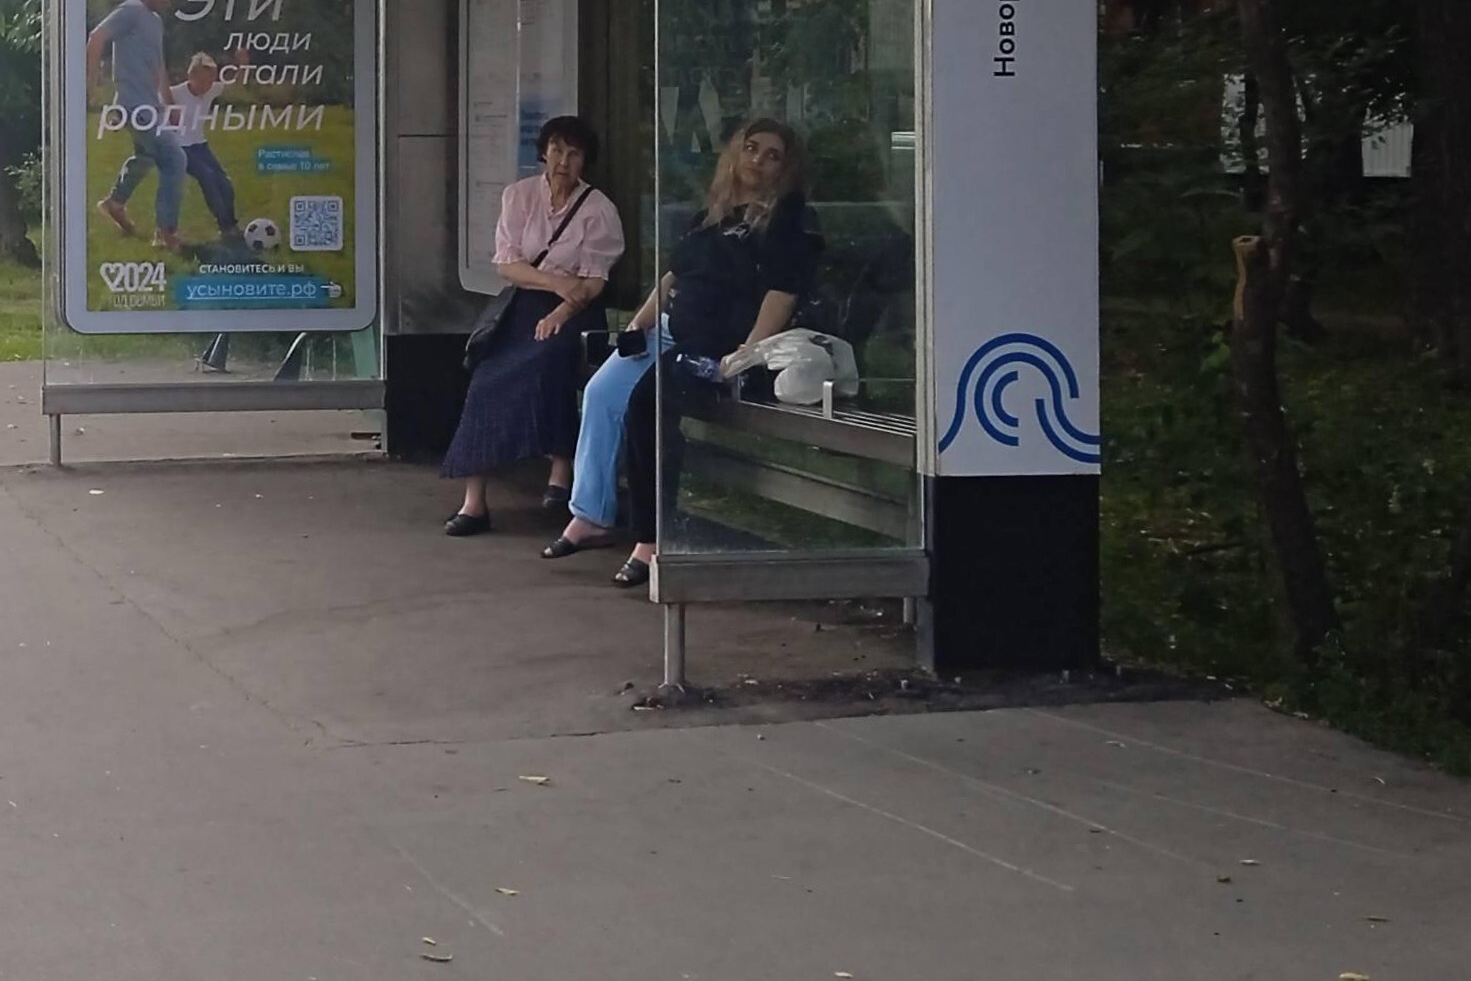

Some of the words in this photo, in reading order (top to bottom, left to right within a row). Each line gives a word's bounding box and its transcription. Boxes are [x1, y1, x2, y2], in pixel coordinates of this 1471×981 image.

[223, 32, 312, 54] люди
[219, 65, 324, 85] стали
[97, 104, 325, 139] родными
[108, 262, 167, 292] 2024
[199, 264, 276, 274] СТАНОВИТЕСЬ
[278, 264, 285, 273] И
[287, 264, 304, 273] ВЫ
[186, 281, 317, 299] усыновите.рф
